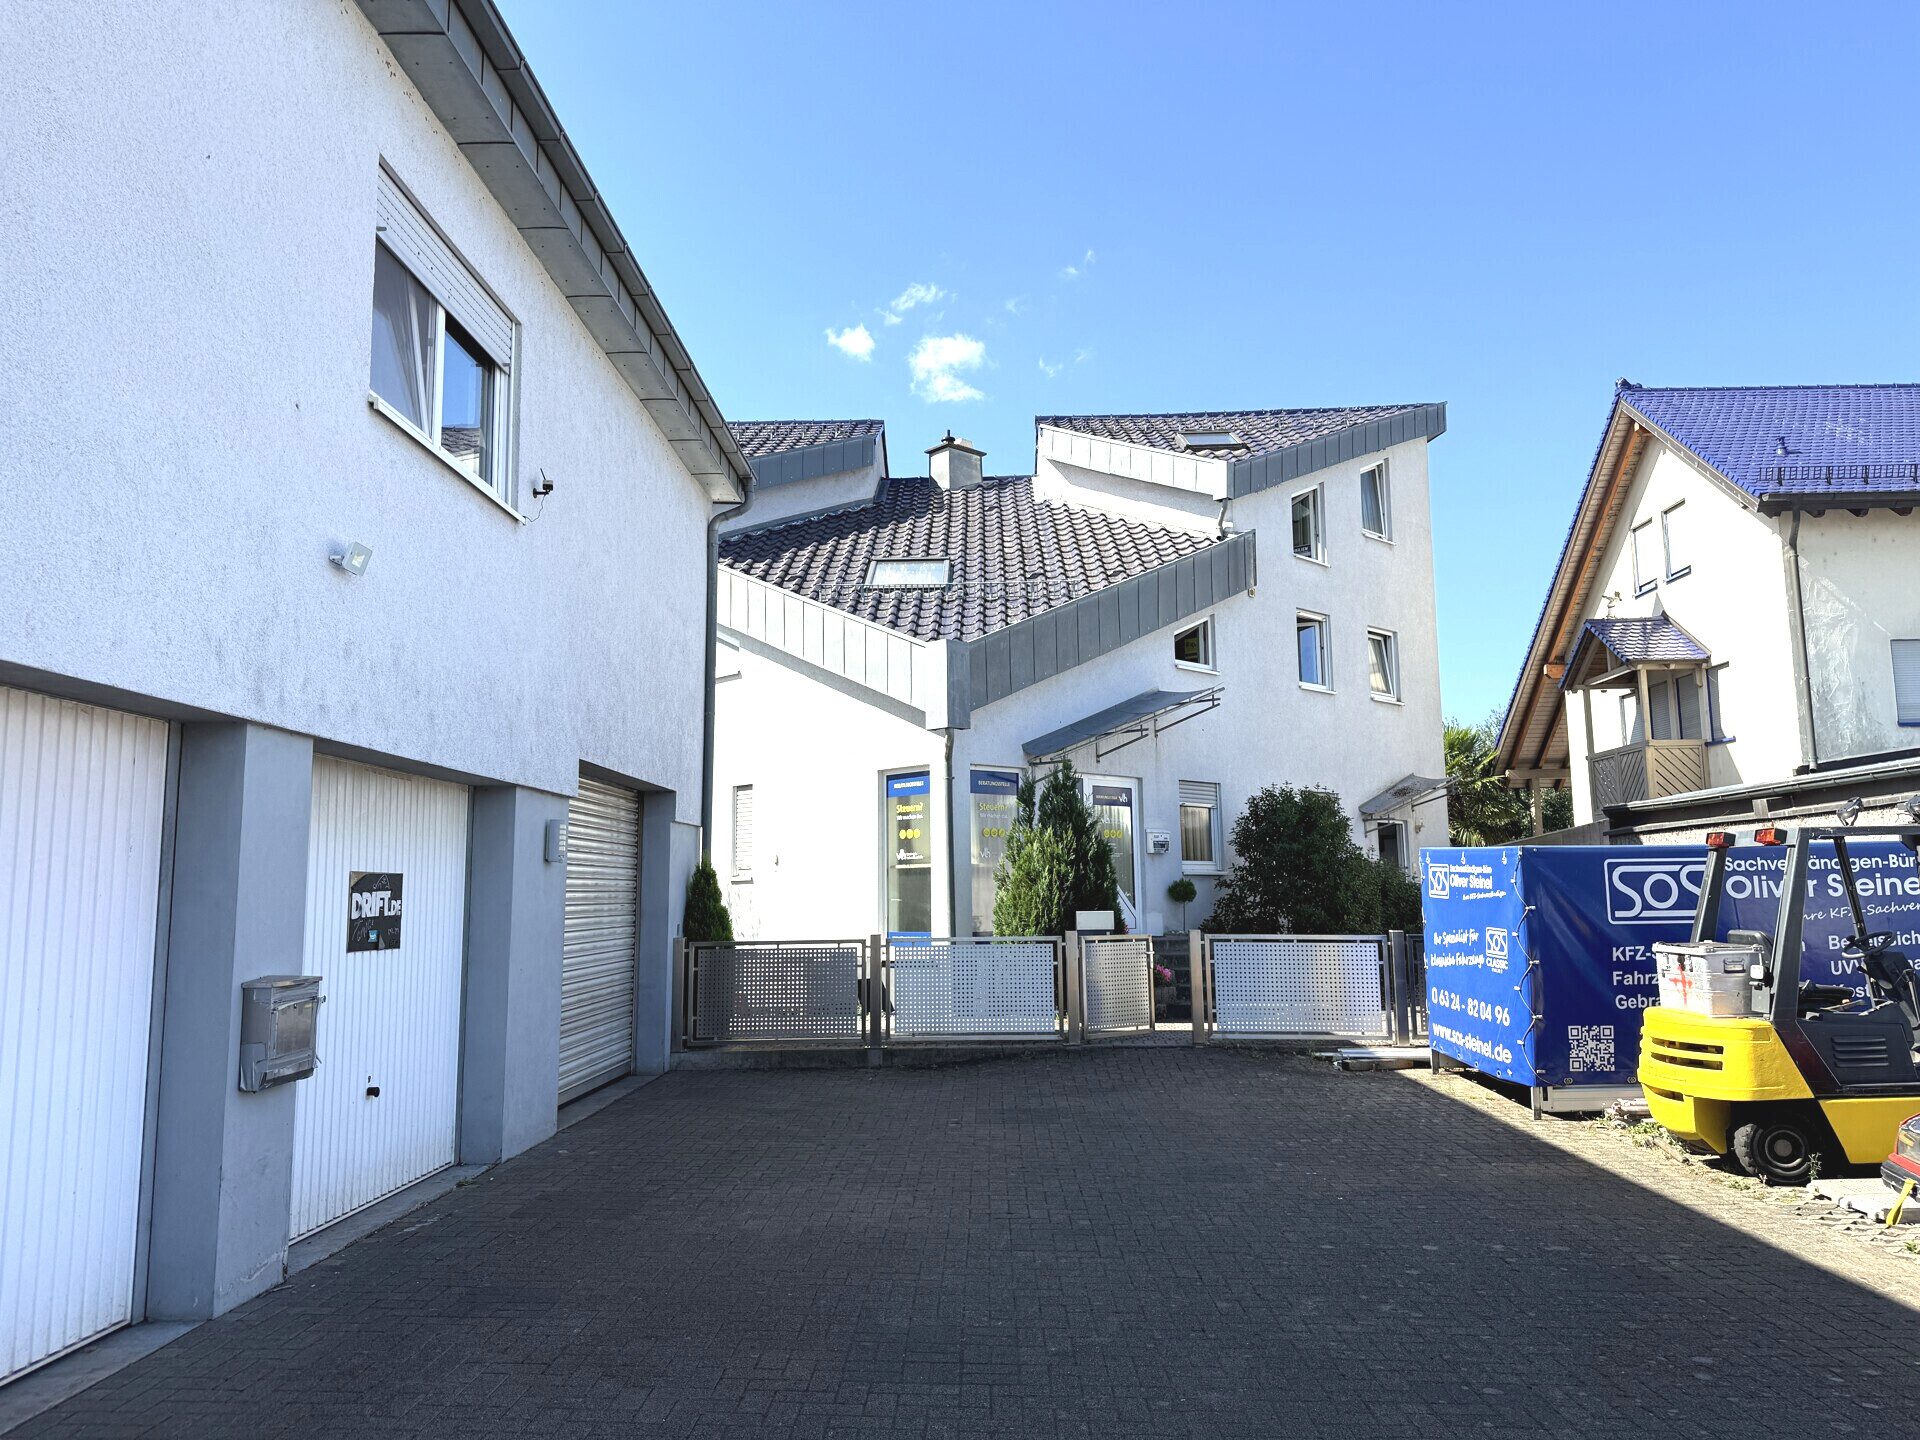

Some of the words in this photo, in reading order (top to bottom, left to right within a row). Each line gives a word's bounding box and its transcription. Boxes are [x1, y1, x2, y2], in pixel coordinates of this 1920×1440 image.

[1429, 865, 1449, 897] SOS
[1450, 874, 1468, 888] Oliver
[1469, 875, 1493, 890] Steinel
[1725, 875, 1817, 899] Olivr
[1827, 873, 1920, 897] Seine
[1486, 928, 1508, 957] SOS
[1612, 946, 1657, 962] KFZ-
[1612, 971, 1658, 986] Fahrz
[1431, 986, 1438, 1004] 0
[1439, 989, 1450, 1008] 63
[1451, 992, 1460, 1012] 24
[1467, 997, 1479, 1018] 82
[1480, 1001, 1492, 1022] 04
[1494, 1005, 1511, 1027] 96
[1615, 994, 1661, 1010] Gebra
[1432, 1022, 1513, 1064] www.sos-steinel.de
